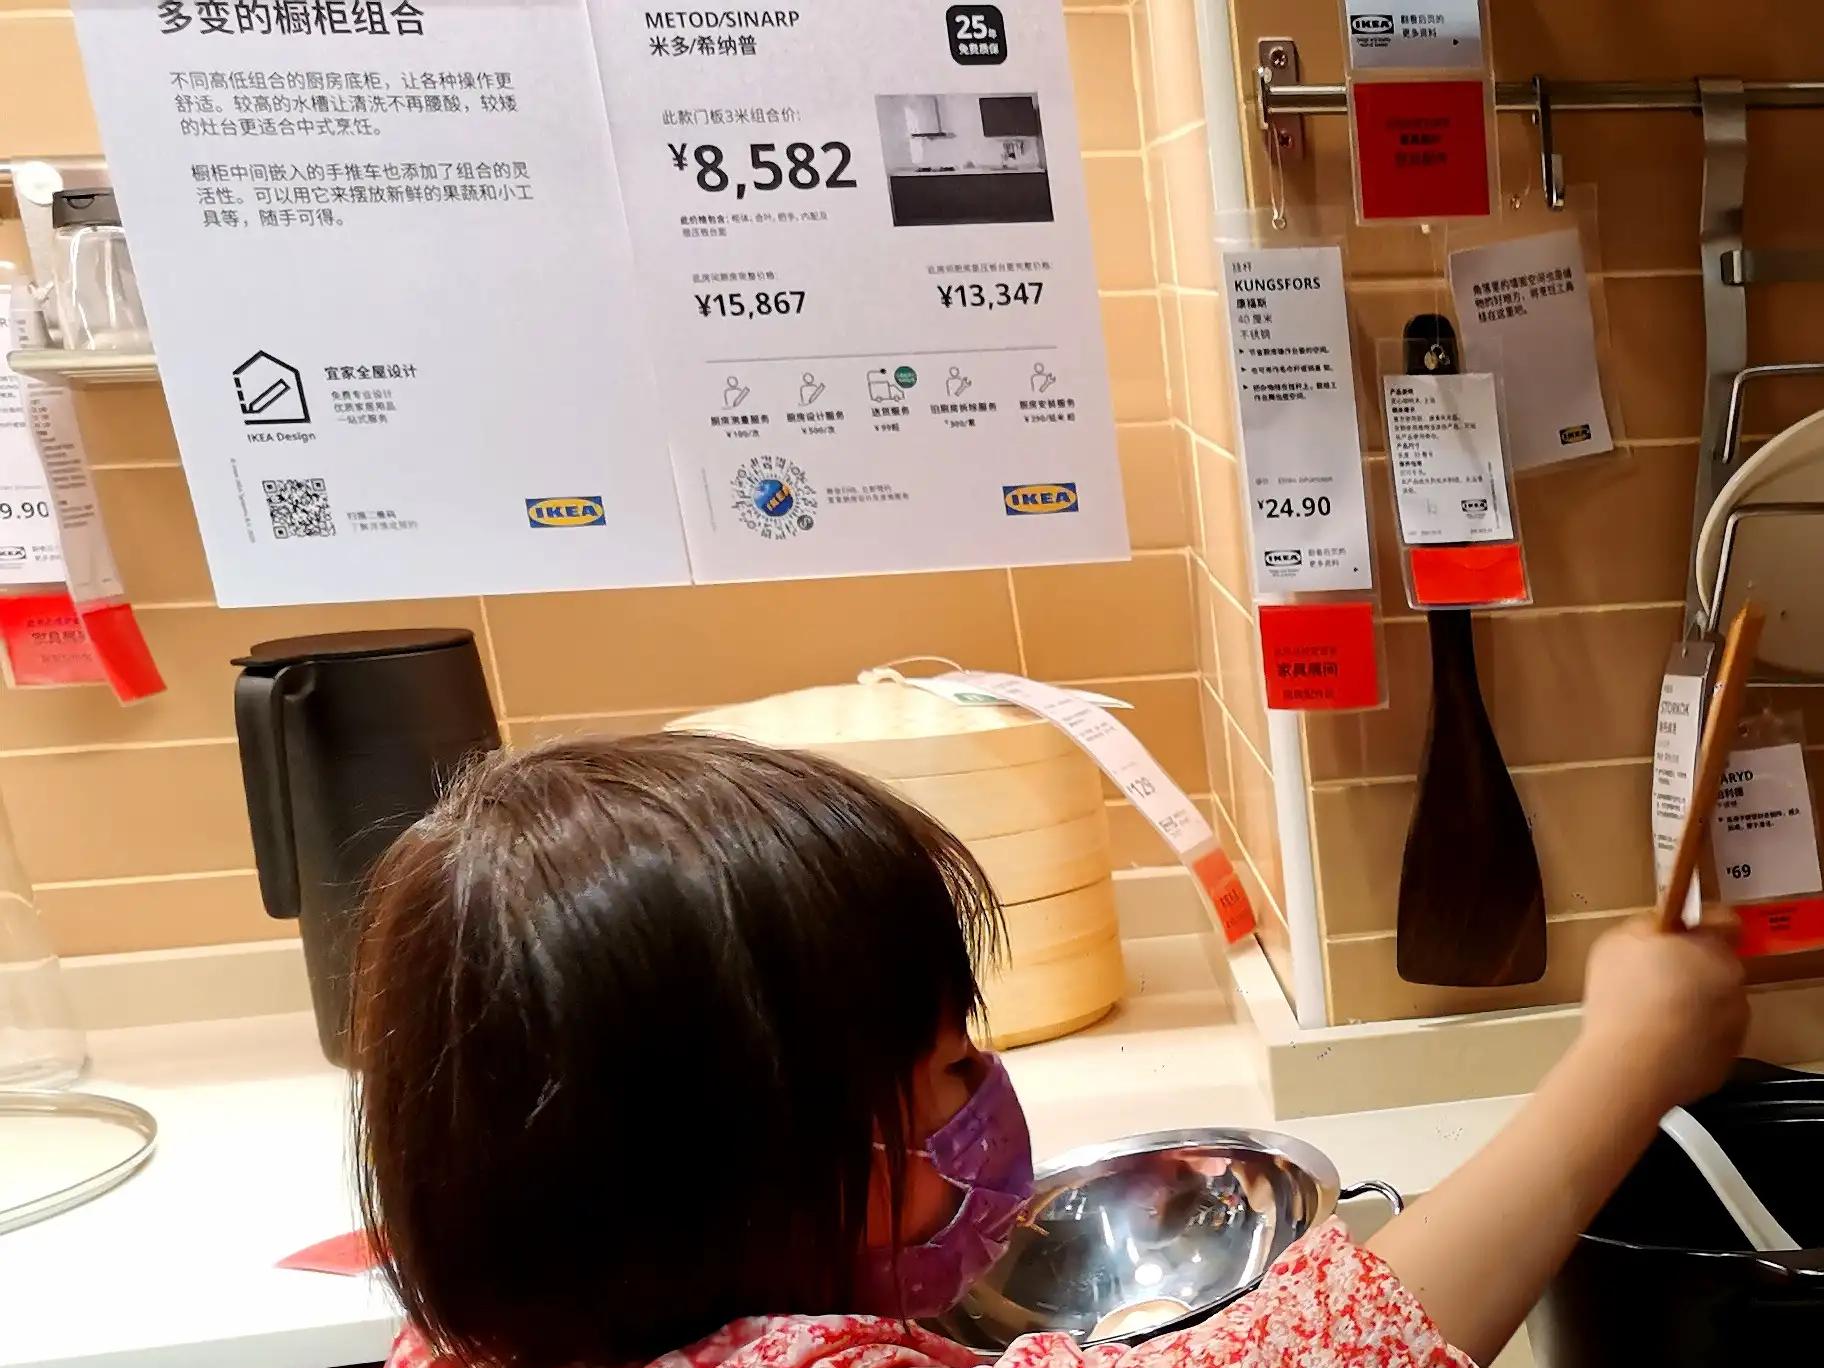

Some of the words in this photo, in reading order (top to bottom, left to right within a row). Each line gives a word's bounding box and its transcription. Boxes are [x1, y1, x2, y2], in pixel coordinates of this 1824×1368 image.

[158, 0, 425, 36] 多变的橱柜组合
[645, 10, 800, 30] METOD/SINARP
[649, 35, 757, 57] 米多/希纳普
[180, 117, 382, 138] 的灶台更适合中式烹饪。
[667, 140, 858, 201] ¥8,582
[203, 208, 345, 229] 具等，随手可得。
[1235, 277, 1321, 292] KUNGSFORS
[695, 290, 806, 319] ¥15,867
[937, 282, 1043, 310] ¥13,347
[325, 364, 417, 381] 宜家全屋设计
[248, 433, 274, 443] IKEA
[277, 432, 316, 444] Design
[1012, 490, 1072, 506] IKEA
[1258, 496, 1331, 519] ¥24.90
[536, 503, 597, 520] IKEA
[1720, 770, 1754, 785] ARYD
